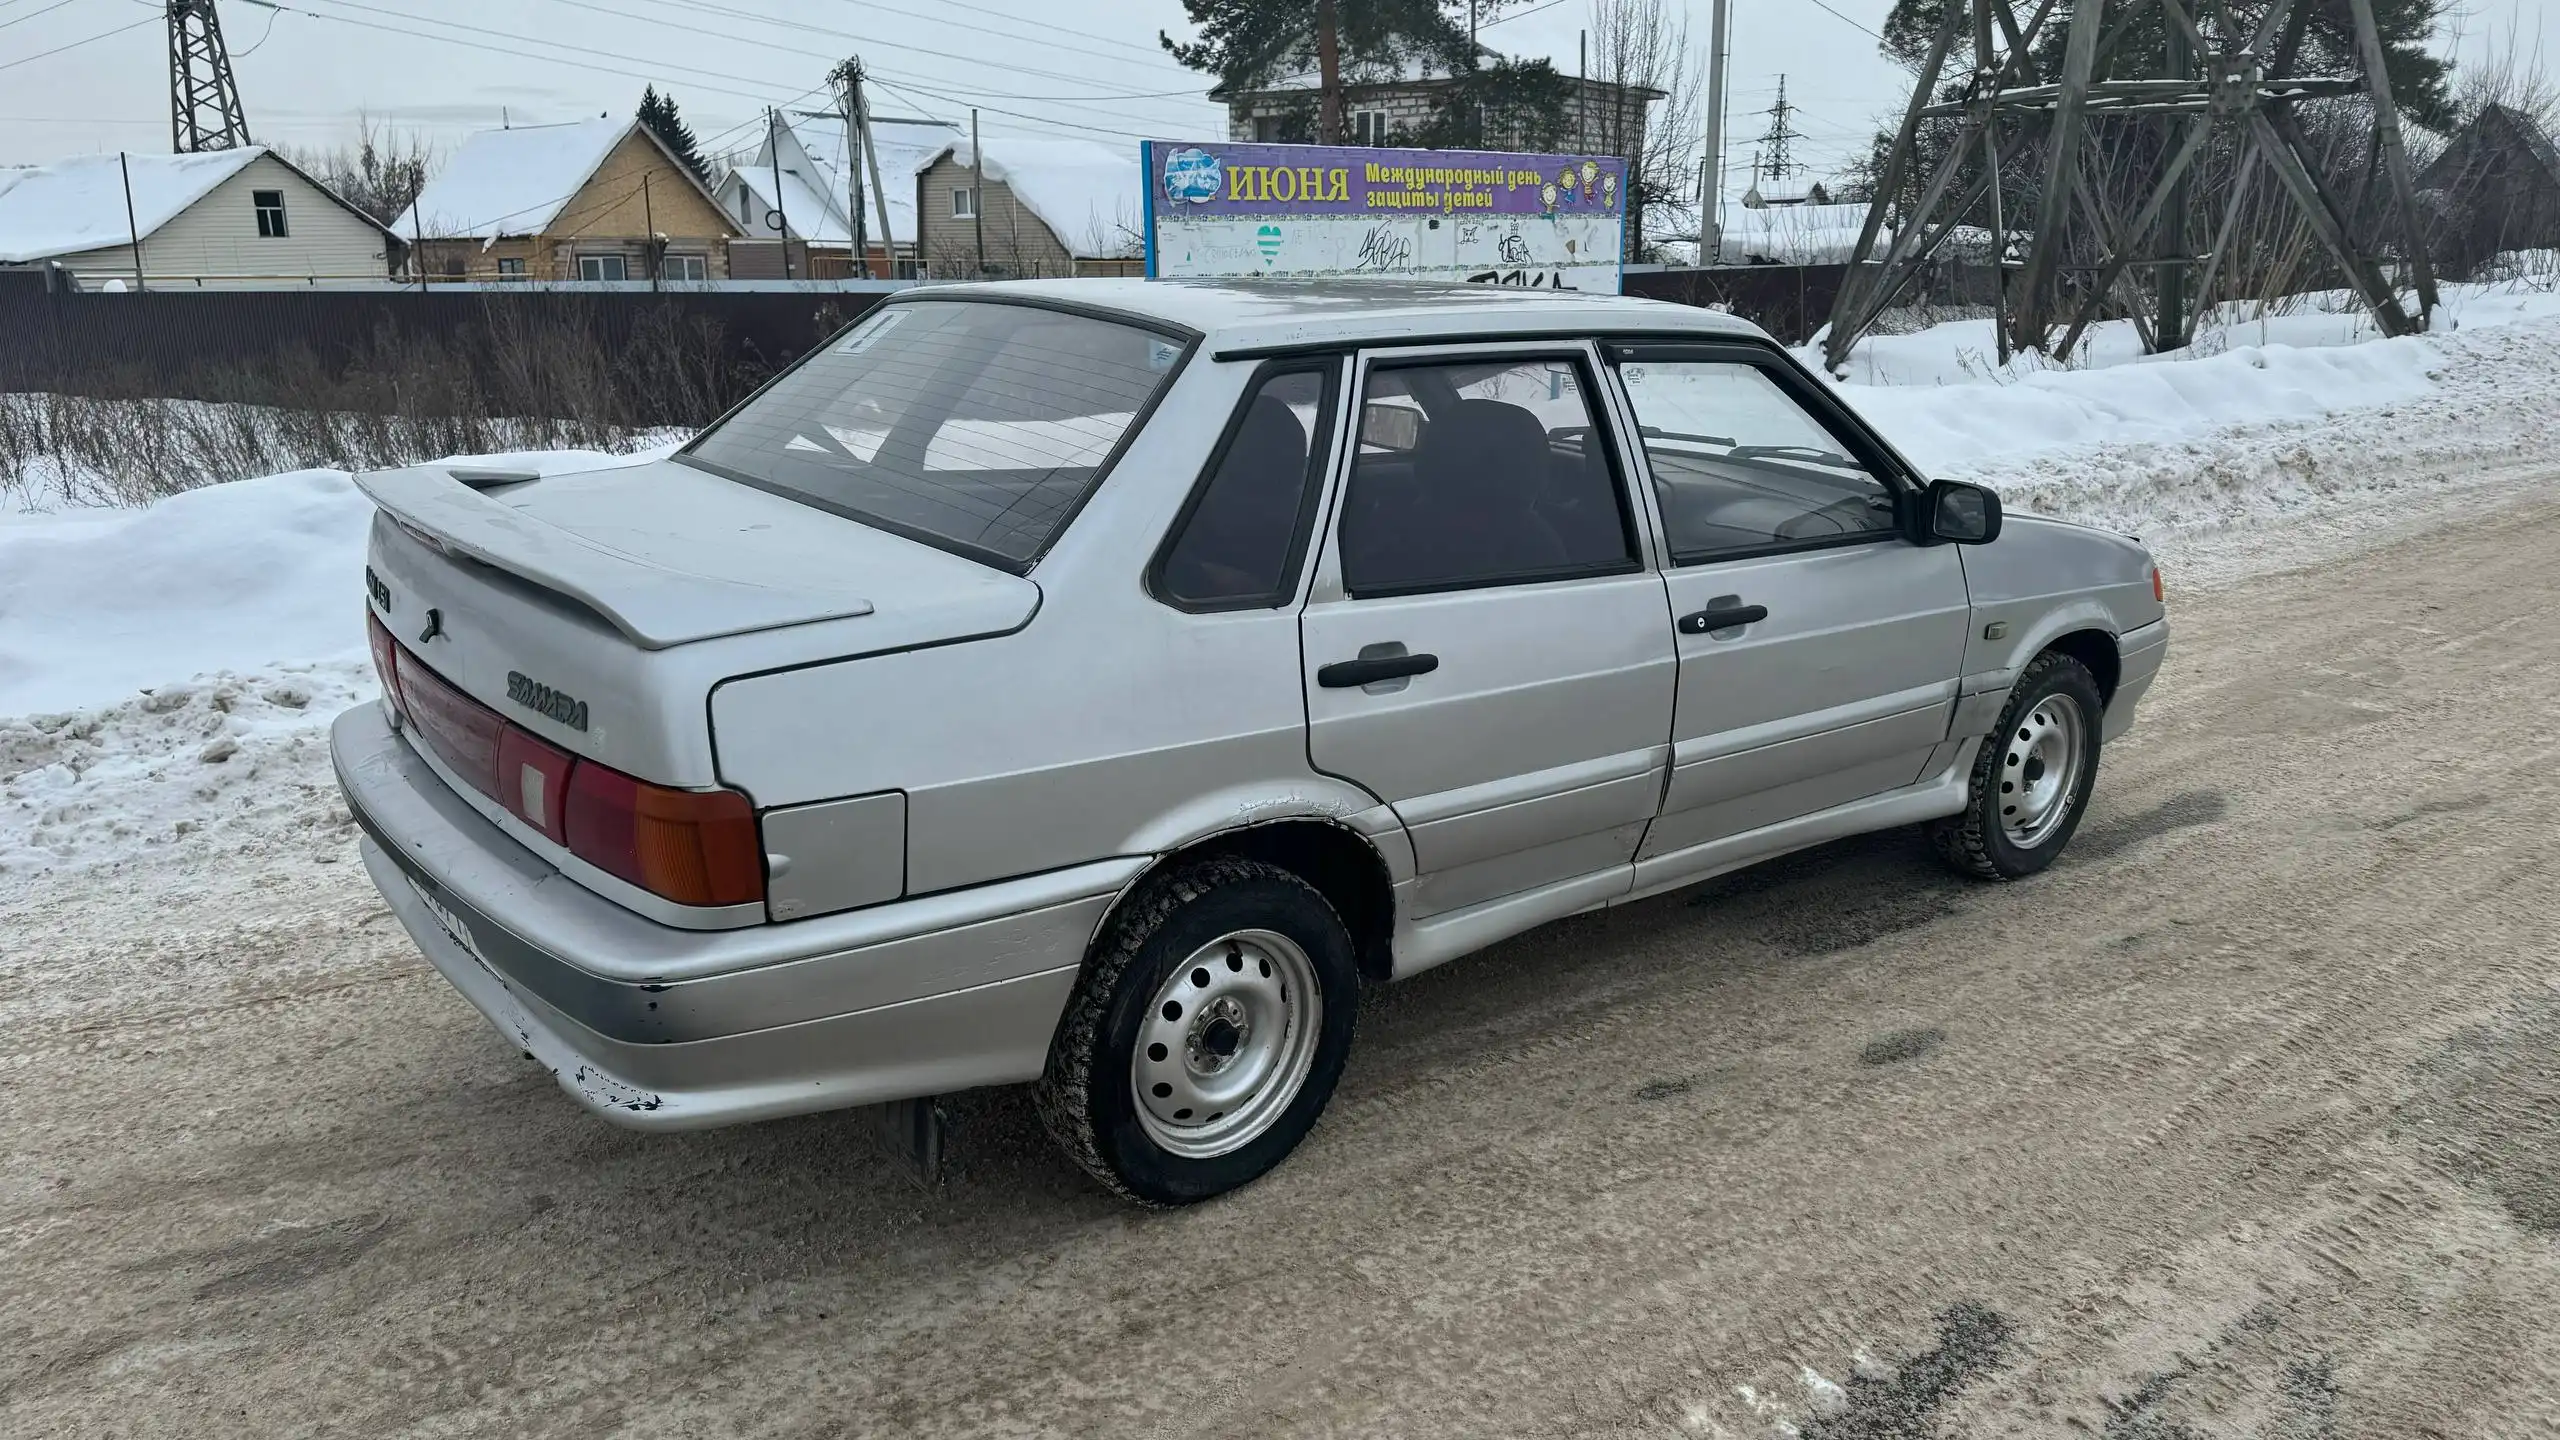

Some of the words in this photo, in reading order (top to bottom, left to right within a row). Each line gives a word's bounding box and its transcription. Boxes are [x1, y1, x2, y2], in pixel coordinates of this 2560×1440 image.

[1226, 166, 1350, 202] ИЮНЯ
[1365, 163, 1504, 191] Международный
[1507, 169, 1542, 192] день
[1366, 190, 1440, 209] защиты
[1443, 188, 1493, 214] детей
[506, 670, 588, 732] SAMARA
